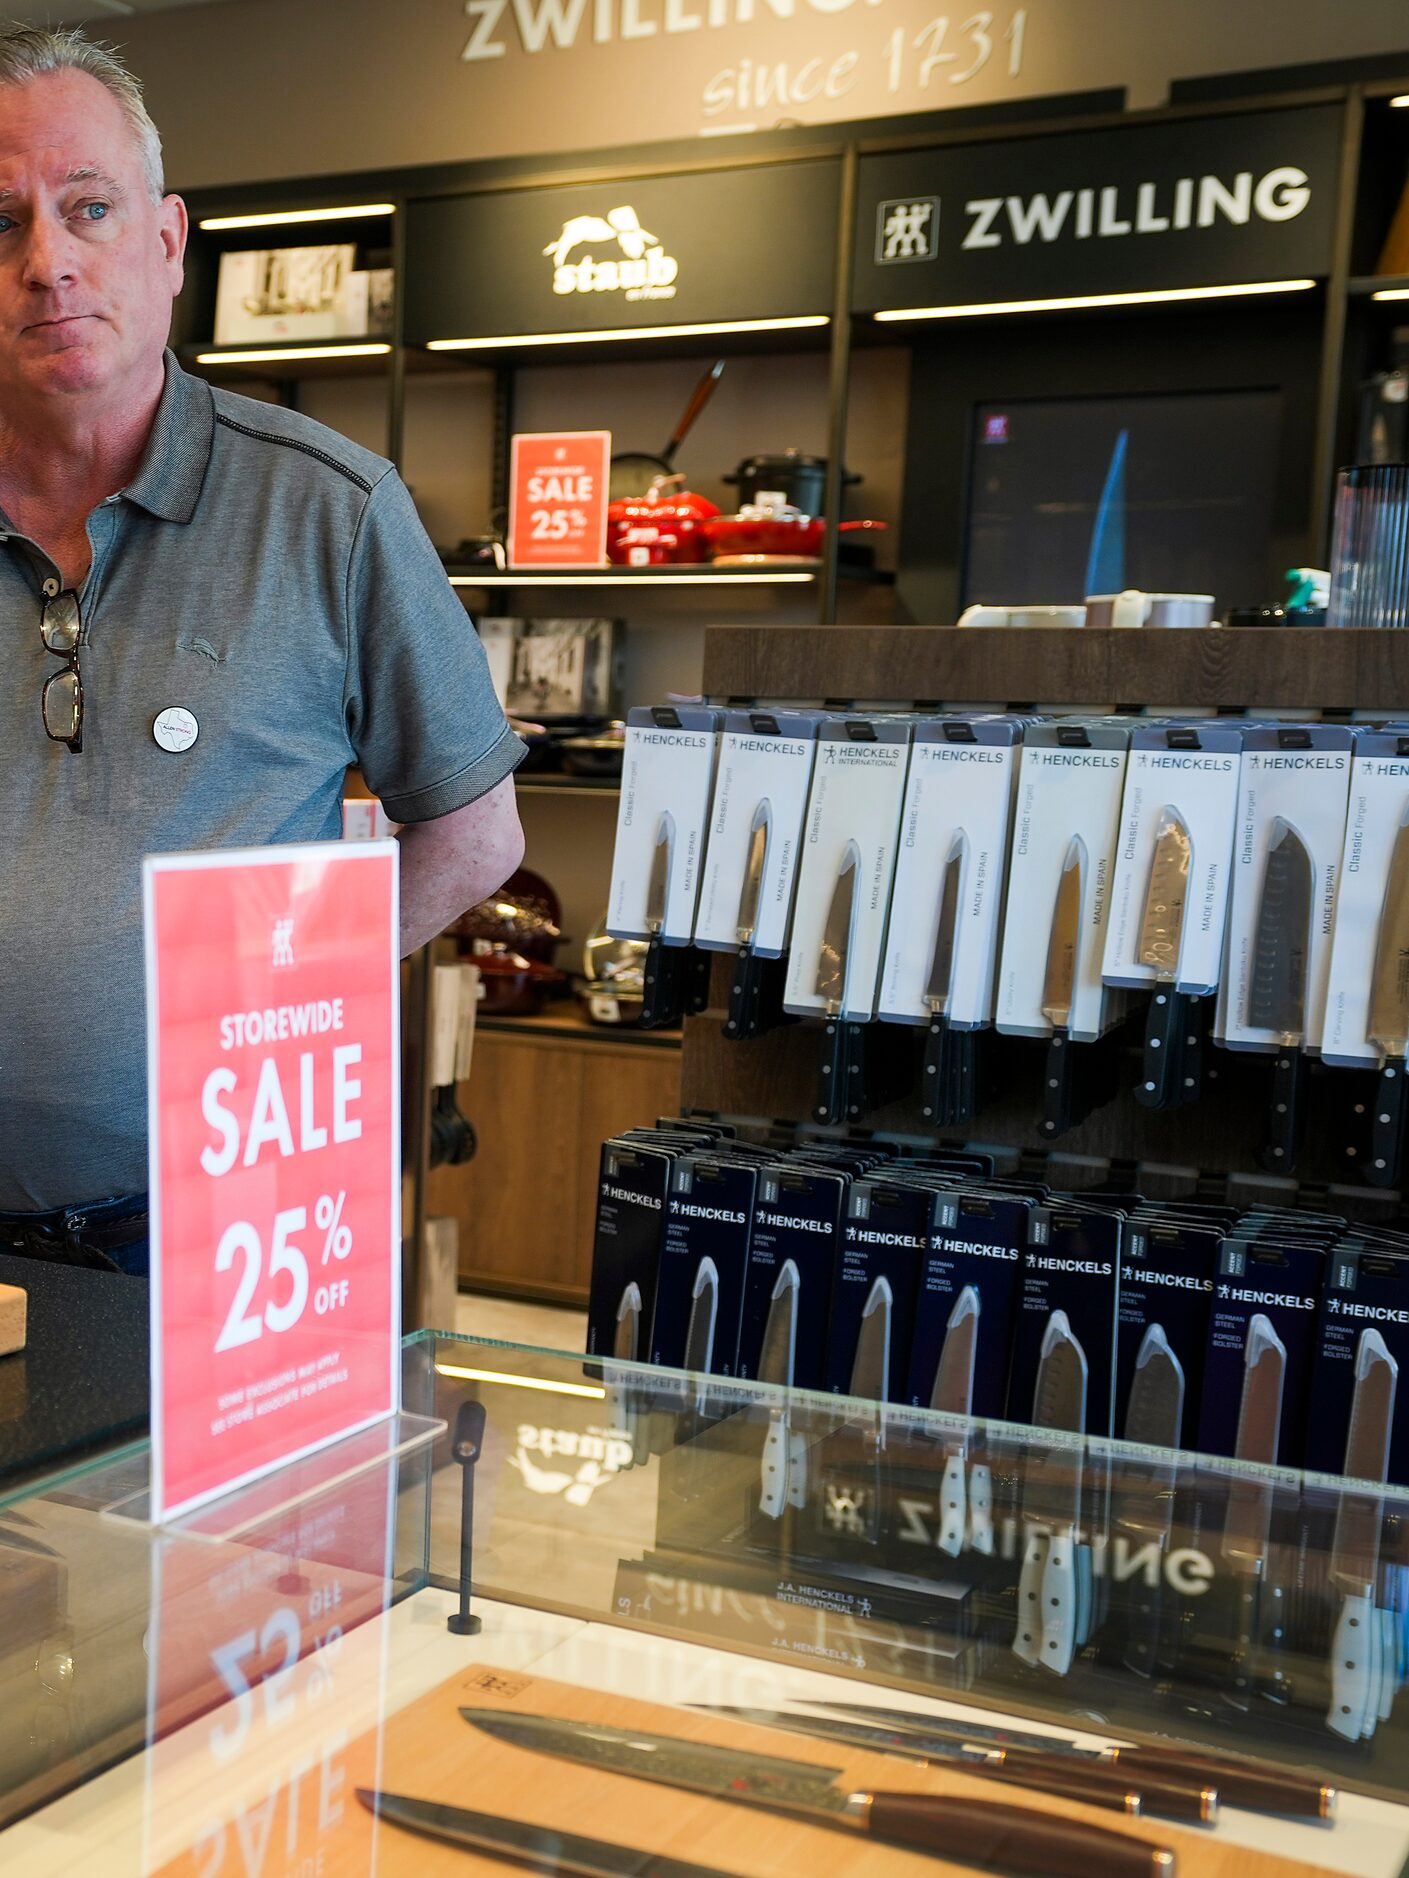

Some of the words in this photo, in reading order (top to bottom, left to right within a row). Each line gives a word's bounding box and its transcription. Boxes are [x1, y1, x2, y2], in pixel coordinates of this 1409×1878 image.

[701, 49, 858, 116] since
[885, 8, 1028, 92] 1731
[961, 166, 1312, 250] ZWILLING
[553, 245, 678, 295] staub
[527, 475, 593, 503] SALE
[644, 734, 707, 748] HENCKELS
[740, 741, 805, 755] HENCKELS
[839, 747, 900, 759] HENCKELS
[932, 751, 1004, 764] HENCKELS
[1042, 754, 1120, 768] HENCKELS
[1150, 758, 1233, 771] HENCKELS
[1263, 757, 1345, 770] HENCKELS
[624, 791, 634, 826] Classic
[716, 798, 728, 833] Classic
[1246, 790, 1256, 821] Forged
[809, 807, 822, 843] Classic
[905, 811, 919, 848] Classic
[1018, 817, 1031, 855] Classic
[1124, 821, 1138, 860] Classic
[1131, 787, 1142, 818] Forged
[1242, 824, 1254, 864] Classic
[1349, 832, 1363, 872] Classic
[1096, 858, 1107, 886] SPAIN
[1207, 863, 1218, 892] SPAIN
[1325, 864, 1335, 893] SPAIN
[1096, 887, 1105, 897] IN
[1205, 893, 1214, 903] IN
[1325, 895, 1333, 905] IN
[1093, 899, 1103, 925] MADE
[1201, 904, 1212, 932] MADE
[1322, 907, 1333, 935] MADE
[220, 999, 343, 1050] STOREWIDE
[199, 1043, 362, 1177] SALE
[611, 1187, 662, 1210] HENCKELS
[681, 1204, 745, 1224] HENCKELS
[767, 1214, 832, 1234] HENCKELS
[858, 1231, 926, 1249] HENCKELS
[944, 1239, 1019, 1260] HENCKELS
[1037, 1257, 1112, 1275] HENCKELS
[1134, 1271, 1213, 1292] HENCKELS
[314, 1279, 349, 1315] OFF
[1232, 1289, 1316, 1310] HENCKELS
[776, 1592, 853, 1616] INTERNATIONAL
[777, 1582, 796, 1594] J.A.
[798, 1585, 855, 1605] HENCKELS
[793, 1641, 849, 1661] HENCKELS
